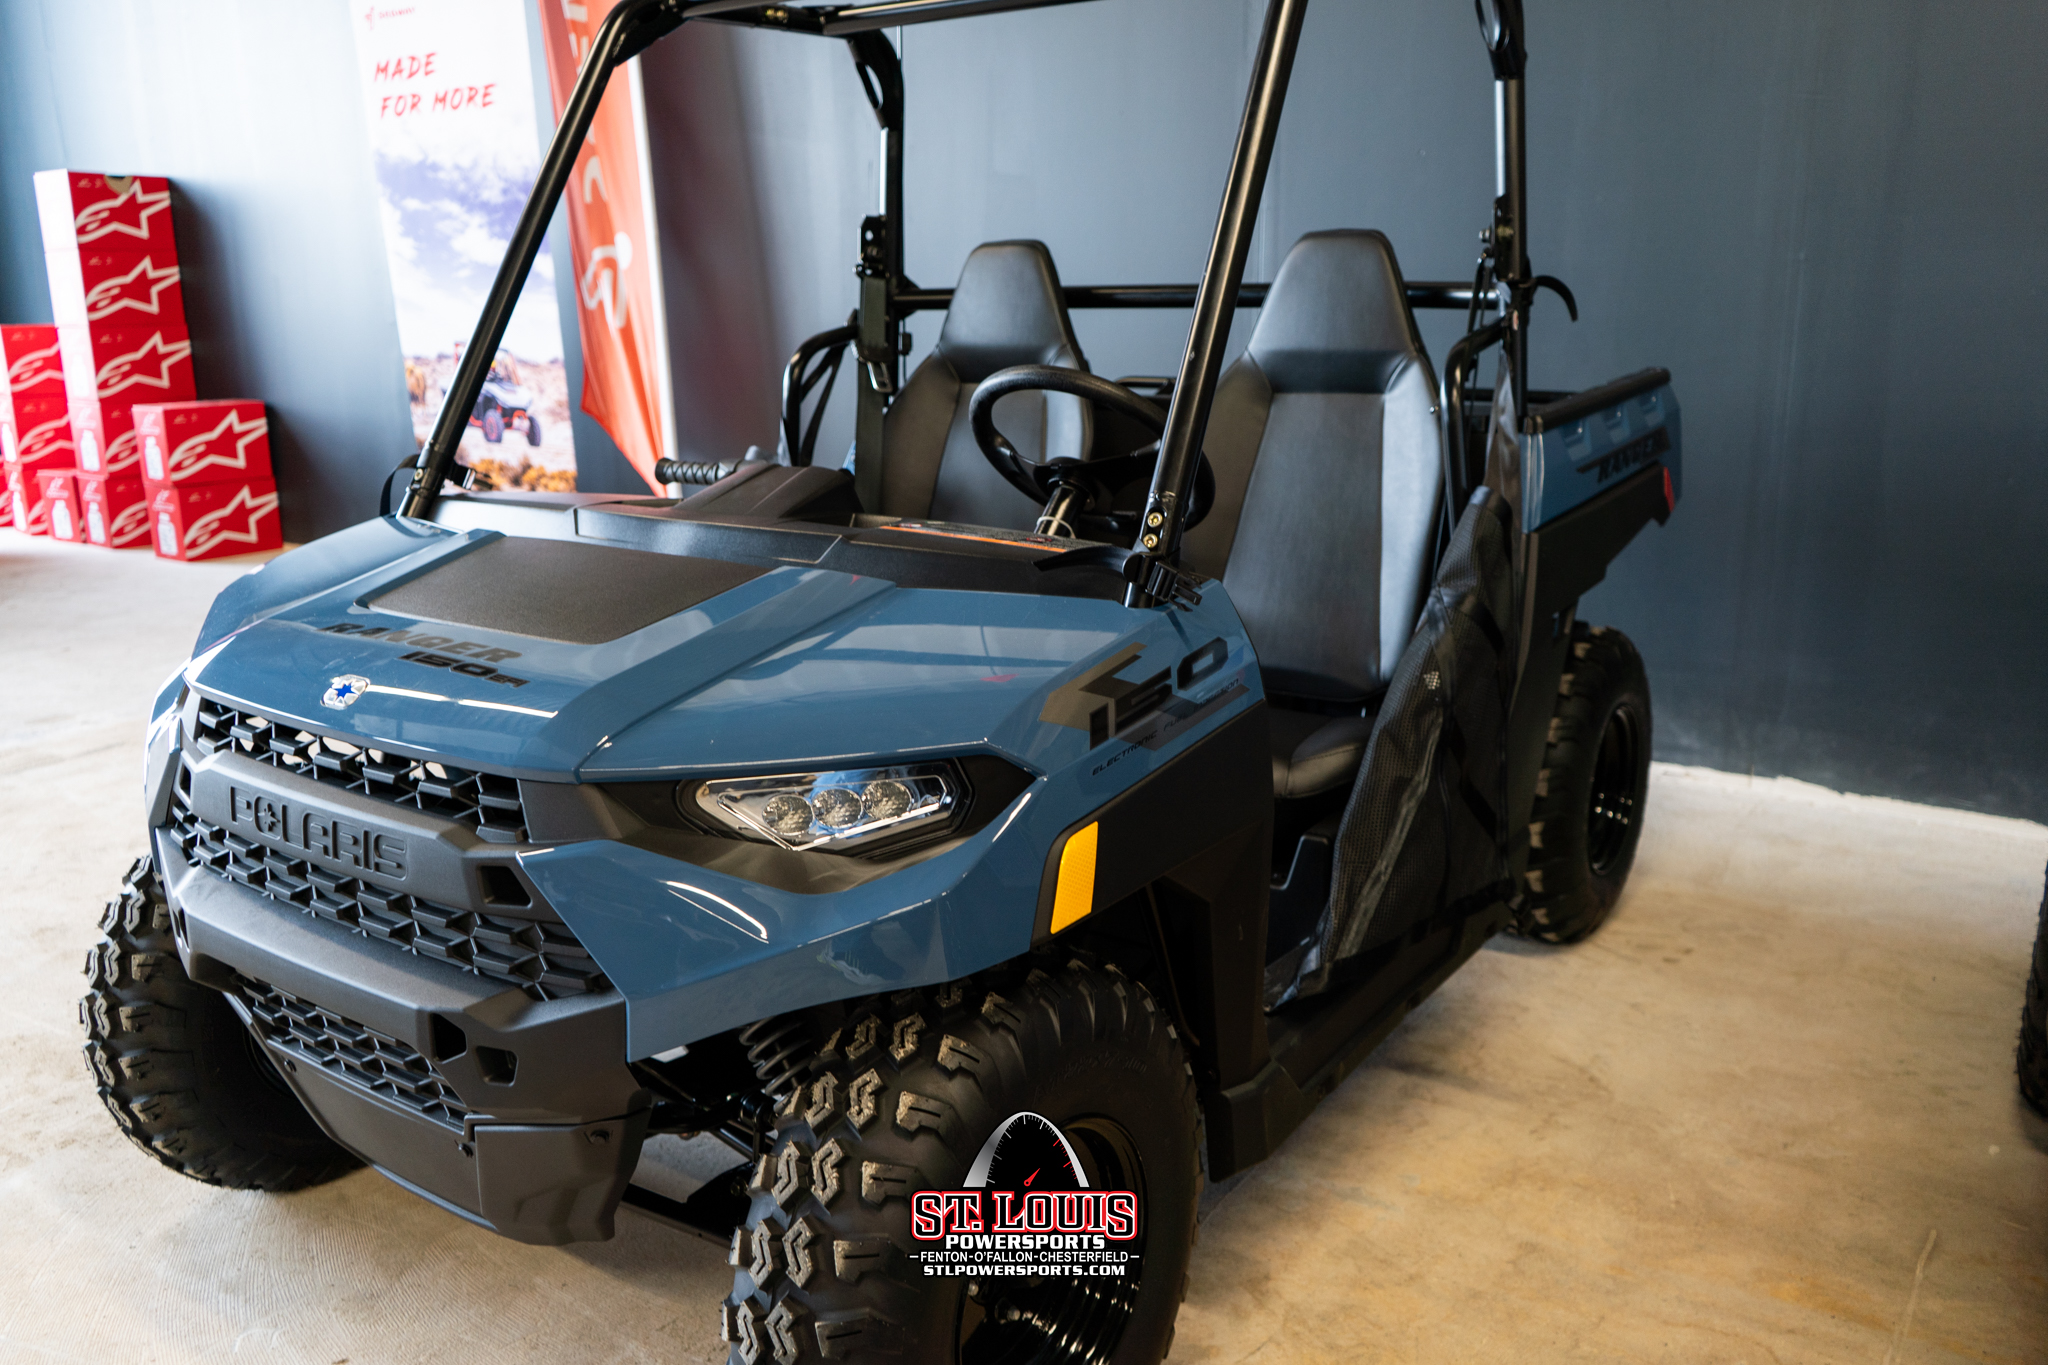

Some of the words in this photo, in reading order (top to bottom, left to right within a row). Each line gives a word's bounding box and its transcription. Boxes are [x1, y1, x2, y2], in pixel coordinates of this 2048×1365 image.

[374, 52, 436, 82] MADE
[380, 93, 422, 119] FOR
[432, 83, 497, 112] MORE
[316, 622, 523, 663] RANGER
[1089, 636, 1229, 750] 150
[1092, 729, 1159, 777] ELECTRONIC
[229, 785, 408, 881] POLARIS
